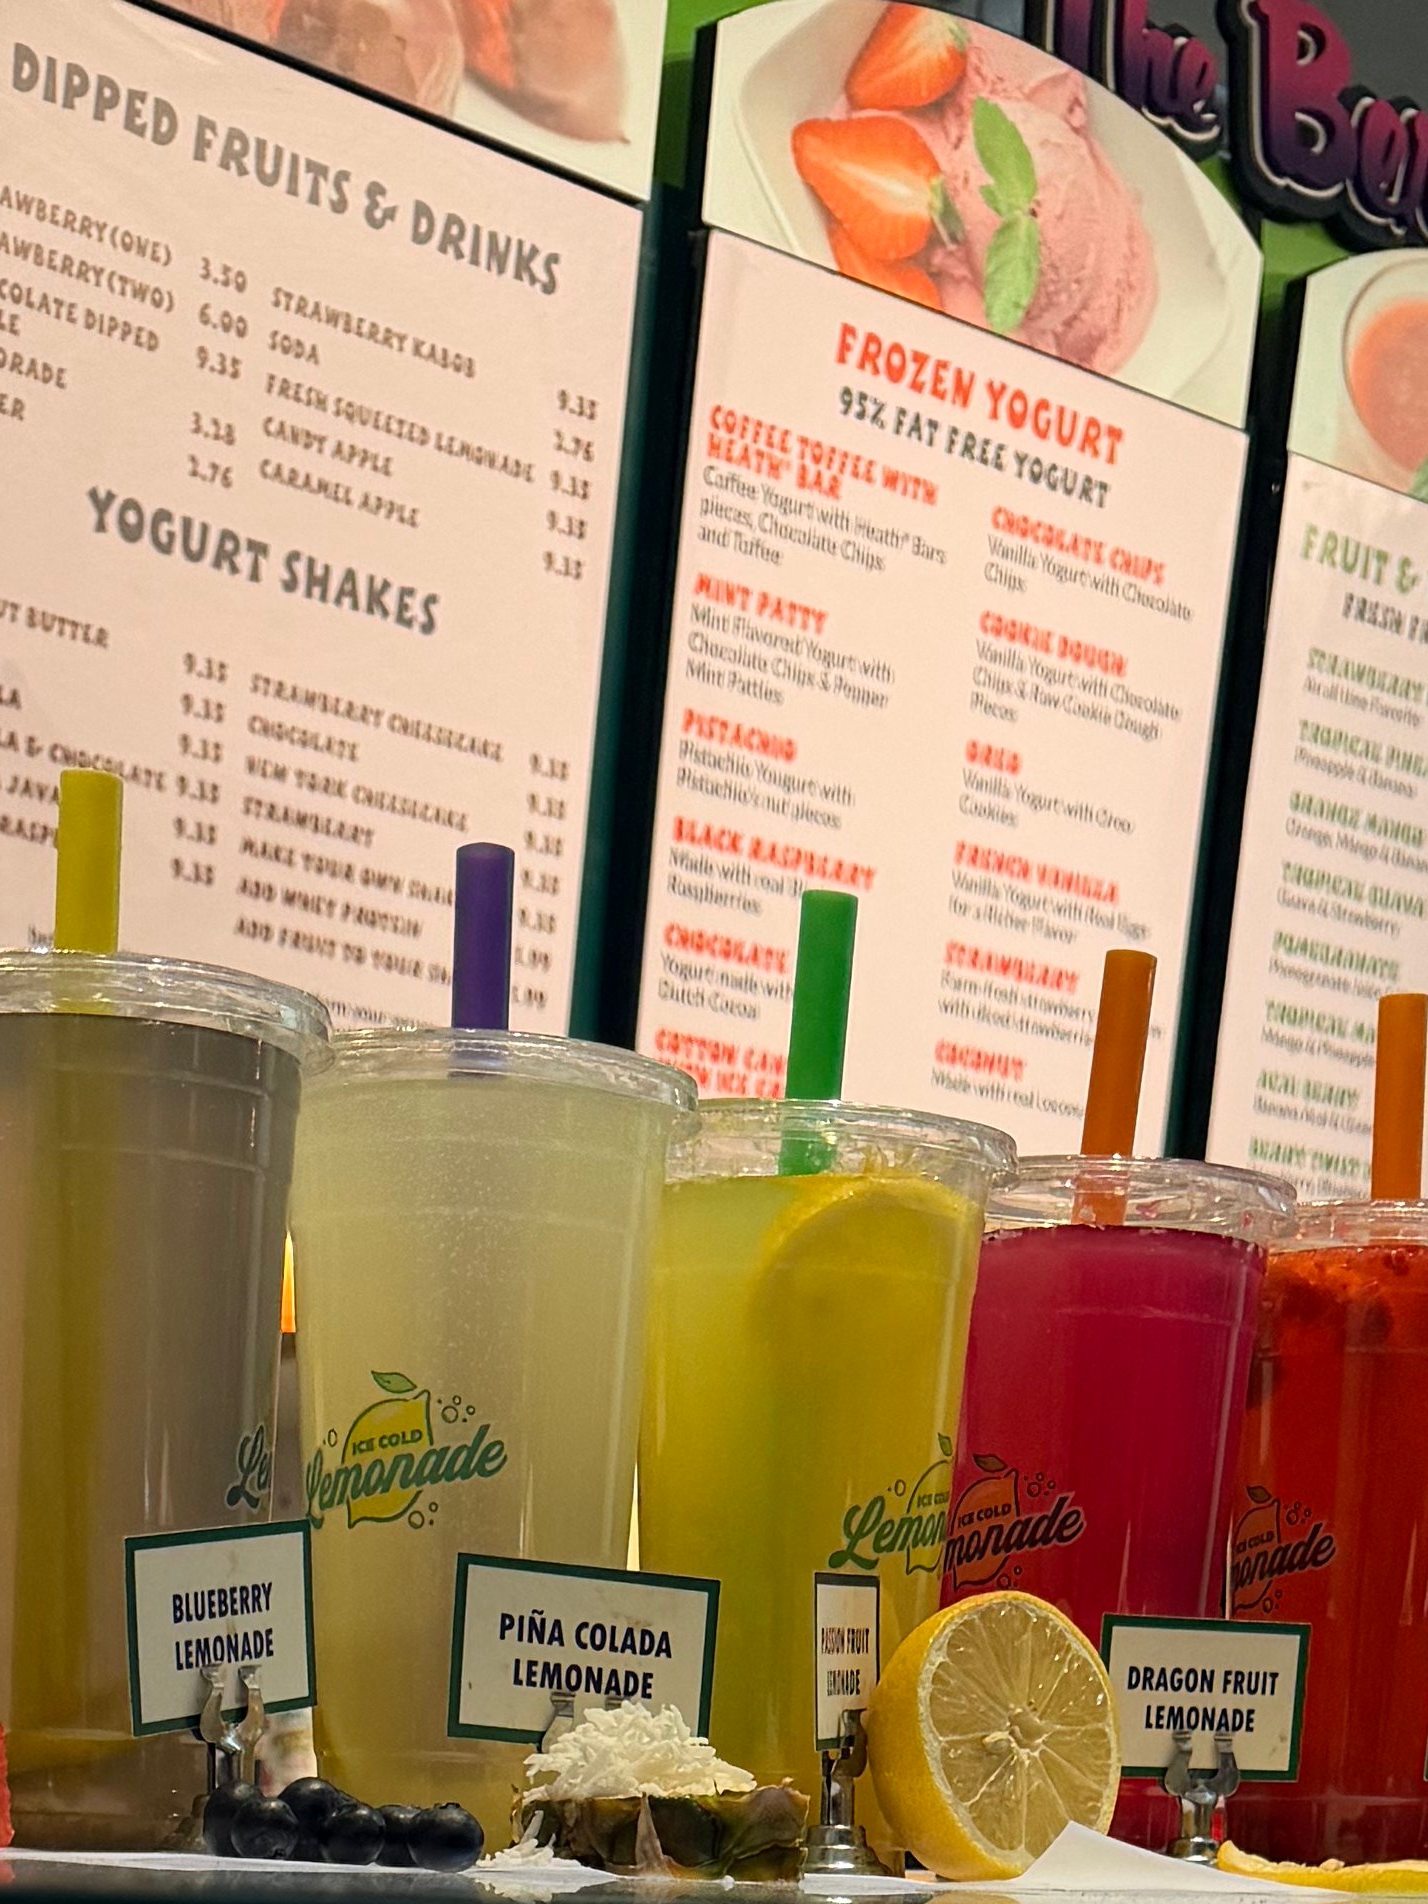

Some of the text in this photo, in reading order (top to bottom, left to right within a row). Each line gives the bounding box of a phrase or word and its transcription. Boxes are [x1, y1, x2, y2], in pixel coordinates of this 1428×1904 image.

[1046, 0, 1220, 142] he
[11, 42, 561, 295] DIPPED FRUITS & DRINKS
[199, 257, 247, 293] 3.50
[198, 303, 248, 338] 6.00
[271, 287, 407, 353] STRAWBERRY
[84, 309, 160, 352] DIPPED
[196, 346, 242, 379] 9.35
[268, 330, 320, 365] SODA
[835, 322, 1125, 465] FROZEN YOGURT
[262, 416, 393, 477] CANDY APPLE
[265, 373, 328, 412] FRESH
[434, 432, 534, 483] LEMONADE
[839, 386, 1110, 508] 95% FAT FREE YOGURT
[709, 404, 939, 505] COFFEE TOFFEE WITH
[259, 459, 420, 528] CARAMEL APPLE
[795, 464, 841, 500] BAR
[86, 486, 442, 635] YOGURT SHAKES
[1300, 522, 1389, 586] FRUIT
[1395, 555, 1419, 595] &
[25, 607, 109, 648] BUTTER
[756, 591, 827, 634] PATTY
[26, 736, 43, 758] &
[352, 1429, 422, 1455] ICE COLD
[306, 1423, 507, 1530] Lemonade
[977, 1503, 1012, 1521] COLD
[172, 1582, 272, 1624] BLUEBERRY
[175, 1628, 274, 1671] LEMONADE
[499, 1609, 672, 1659] PIÑA COLADA
[847, 1628, 869, 1654] FRUIT
[513, 1659, 654, 1700] LEMONADE
[1127, 1665, 1278, 1696] DRAGON FRUIT
[1145, 1705, 1255, 1734] LEMONADE
